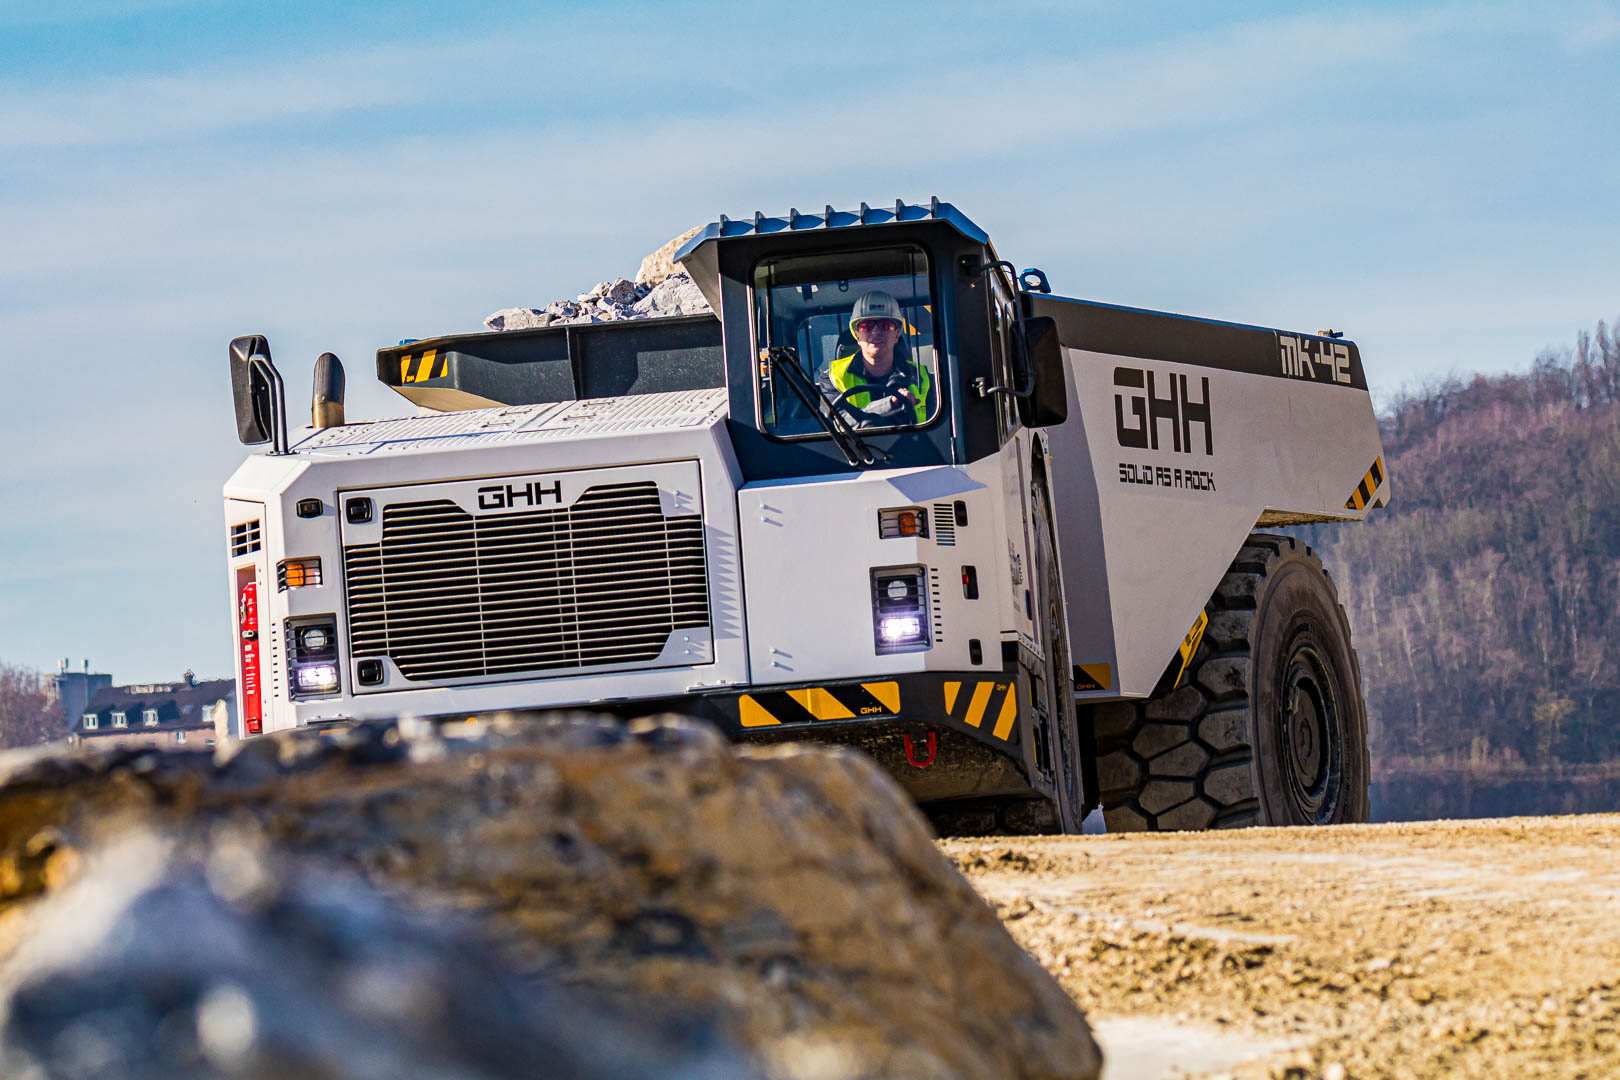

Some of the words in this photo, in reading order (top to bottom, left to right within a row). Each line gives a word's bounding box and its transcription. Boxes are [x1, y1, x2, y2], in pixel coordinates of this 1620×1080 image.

[1113, 366, 1214, 456] GHH
[1156, 467, 1172, 487] AS
[1174, 469, 1183, 488] A
[1185, 470, 1216, 491] ROCK
[478, 480, 562, 510] GHH
[860, 706, 882, 715] GHH
